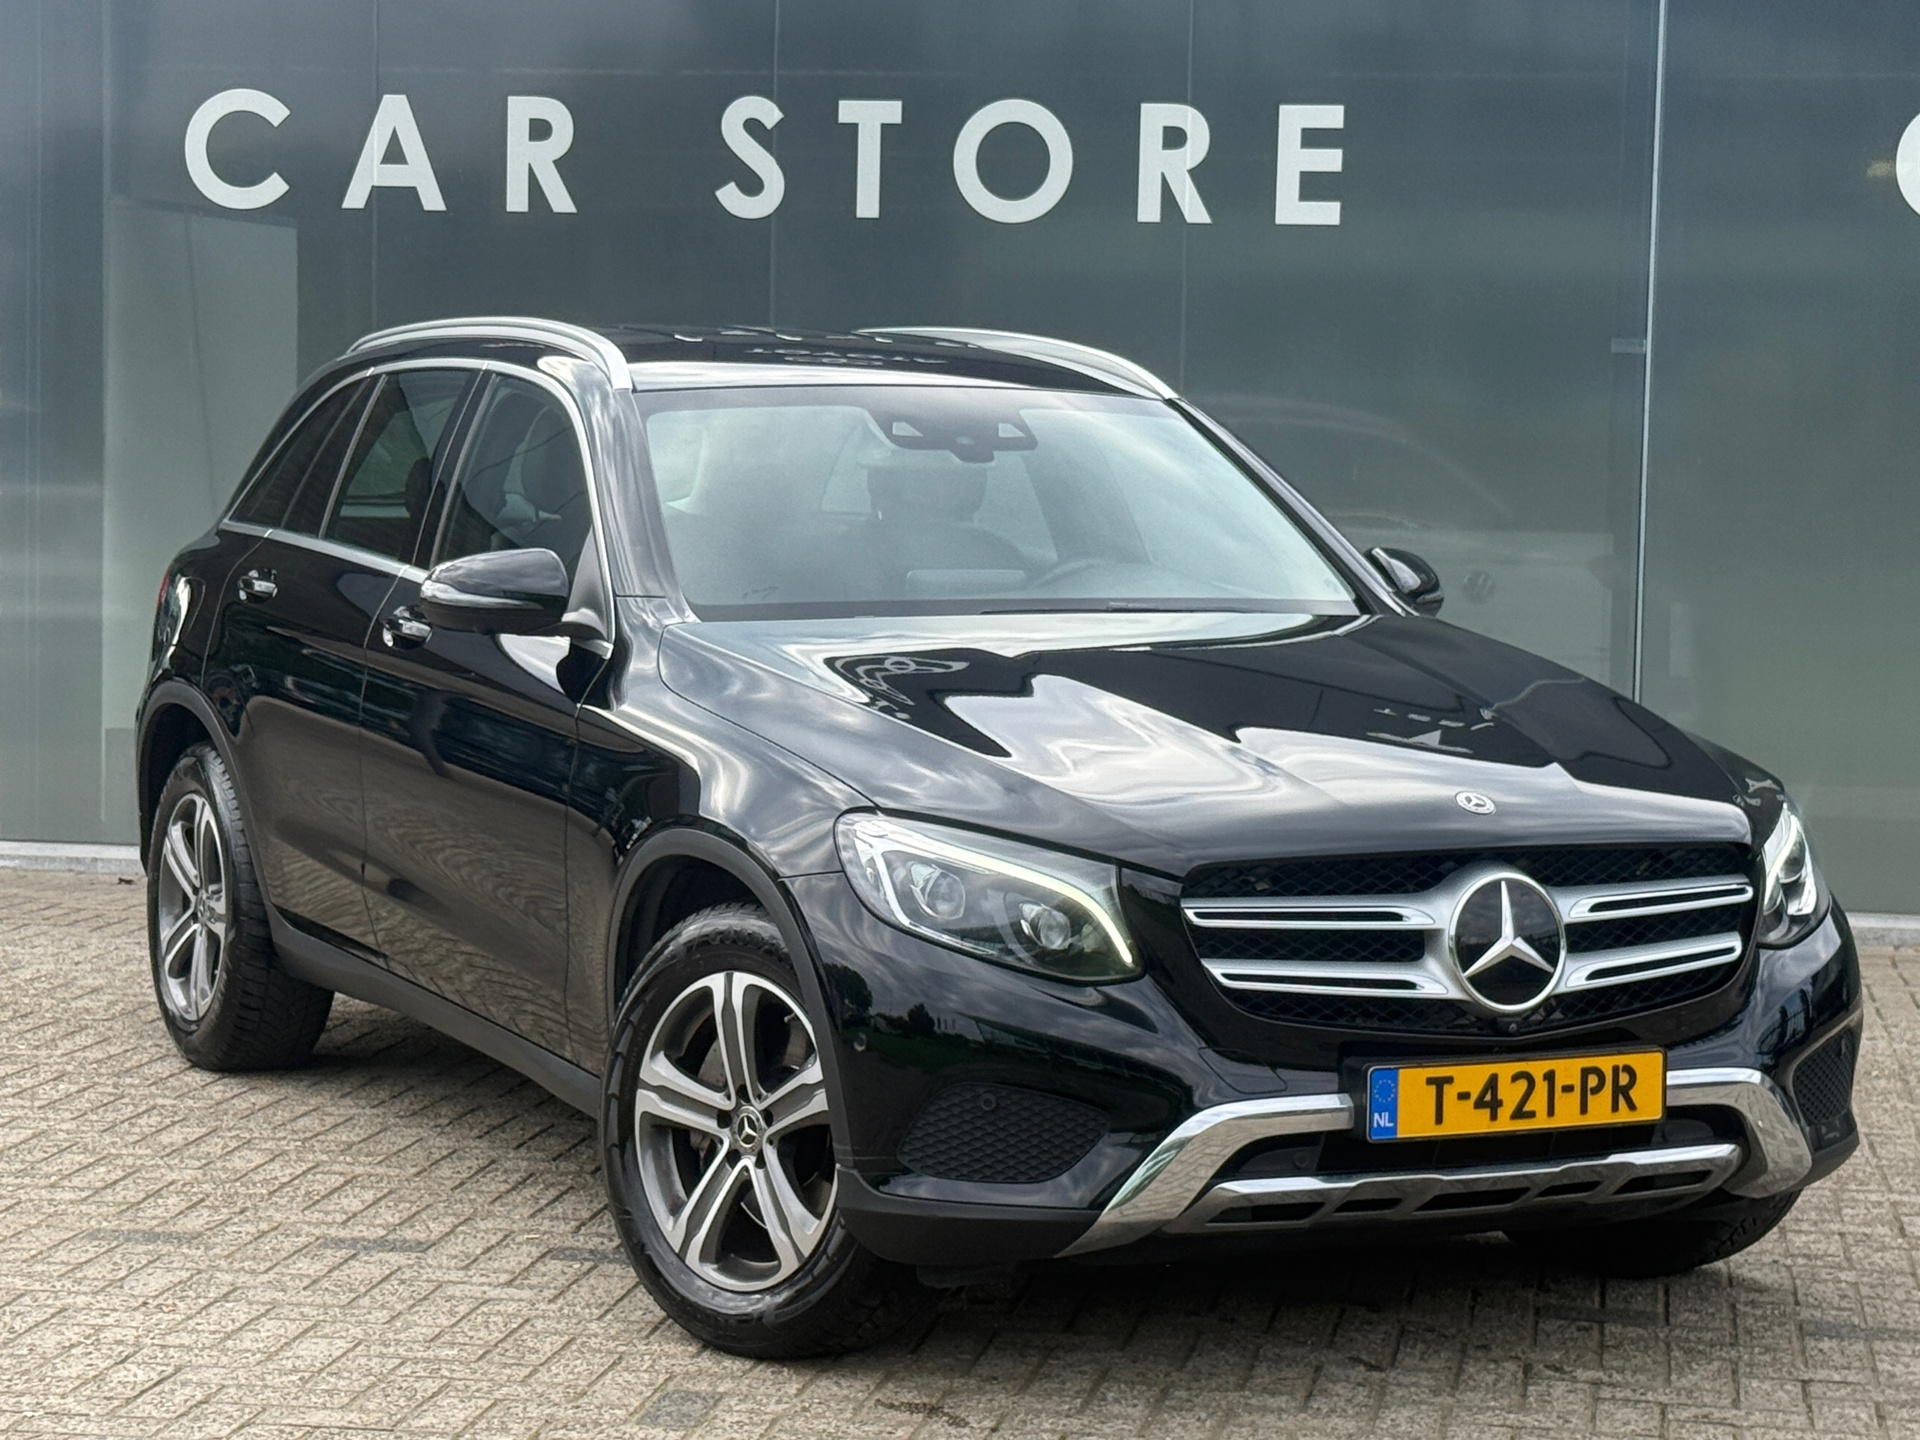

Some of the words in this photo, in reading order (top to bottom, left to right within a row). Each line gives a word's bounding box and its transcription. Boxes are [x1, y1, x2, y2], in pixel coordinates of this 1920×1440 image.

[185, 88, 577, 213] CAR
[715, 96, 1345, 225] STORE
[1373, 1111, 1394, 1128] NL
[1426, 1064, 1637, 1125] T-421-PR
